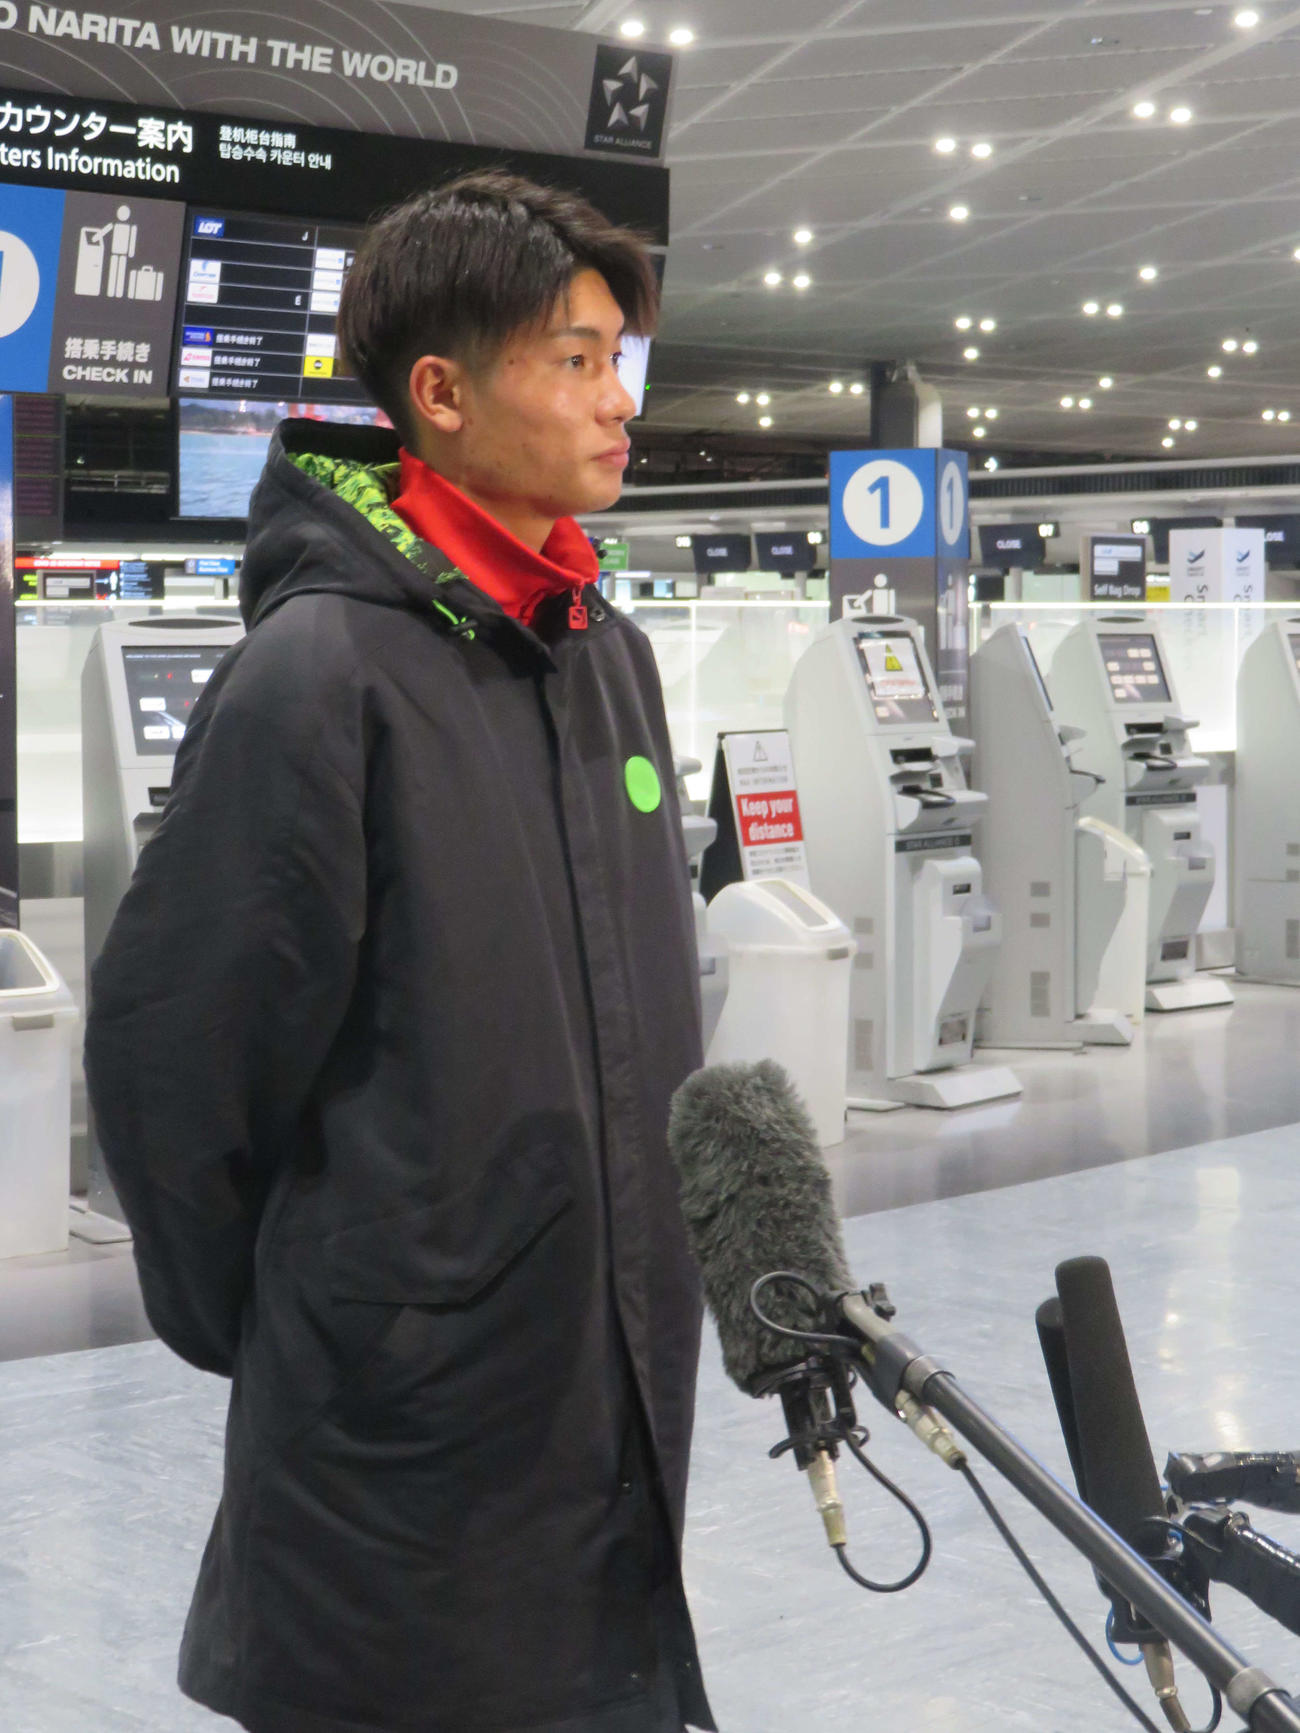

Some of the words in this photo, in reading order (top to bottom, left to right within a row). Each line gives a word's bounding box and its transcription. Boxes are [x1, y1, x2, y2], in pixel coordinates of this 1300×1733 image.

[28, 5, 160, 50] NARITA
[171, 25, 258, 63] WITH
[267, 40, 334, 73] THE
[341, 50, 458, 89] WORLD
[0, 101, 193, 153] カウンター案内
[219, 124, 297, 149] 登机柜台指南
[47, 147, 180, 183] Information
[219, 142, 267, 163] 탑승수속
[270, 148, 305, 167] 카운터
[308, 153, 332, 170] 안내
[64, 337, 150, 362] 搭乗手続き
[62, 365, 129, 383] CHECK
[133, 369, 153, 384] IN
[867, 475, 890, 529] 1
[946, 475, 954, 530] 1
[996, 540, 1022, 549] CLOSE
[740, 798, 768, 819] Keep
[770, 797, 793, 818] your
[748, 822, 794, 841] distance
